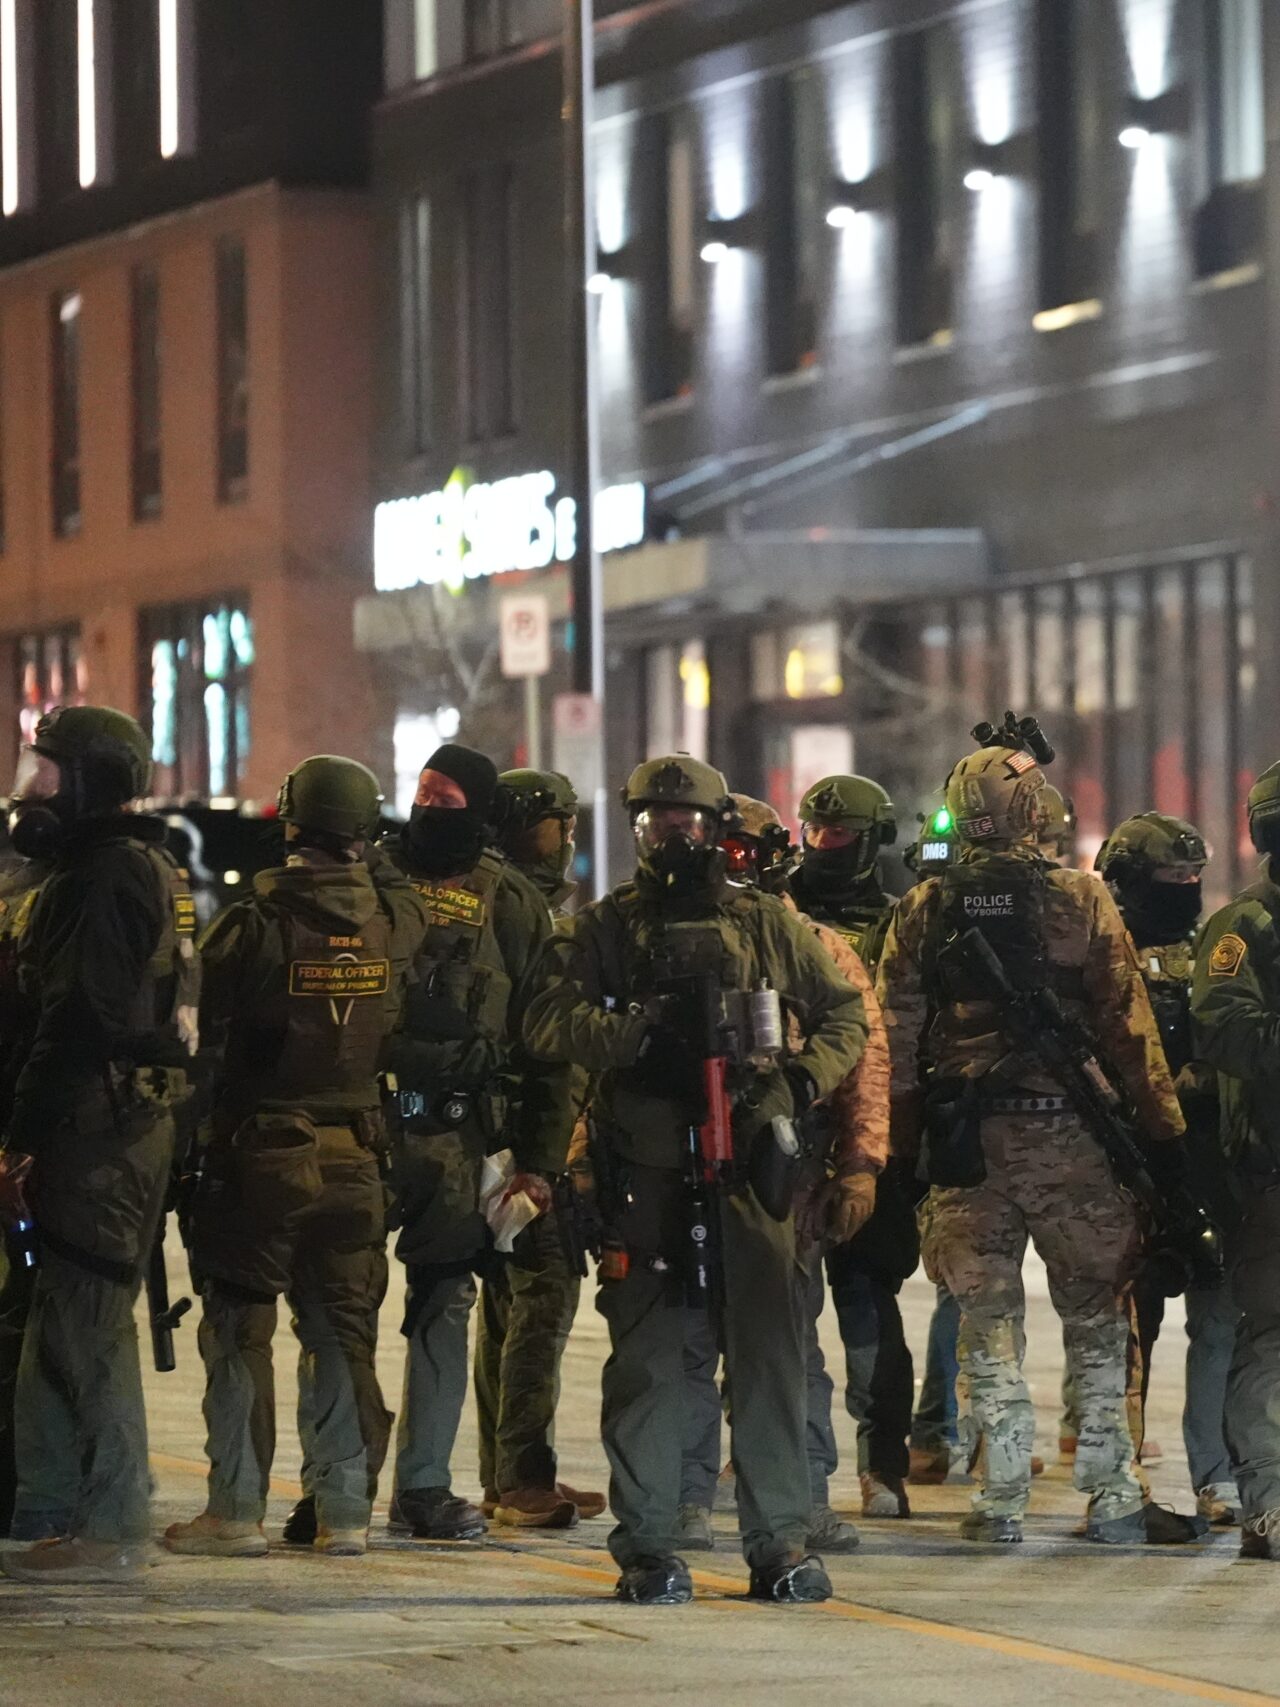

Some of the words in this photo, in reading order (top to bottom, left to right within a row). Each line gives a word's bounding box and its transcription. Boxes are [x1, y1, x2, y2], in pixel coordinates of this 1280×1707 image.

[922, 843, 948, 860] DM8
[436, 888, 479, 909] OFFICER
[964, 894, 1014, 908] POLICE
[979, 907, 1014, 917] BORTAC
[299, 967, 343, 978] FEDERAL
[345, 965, 385, 978] OFFICER
